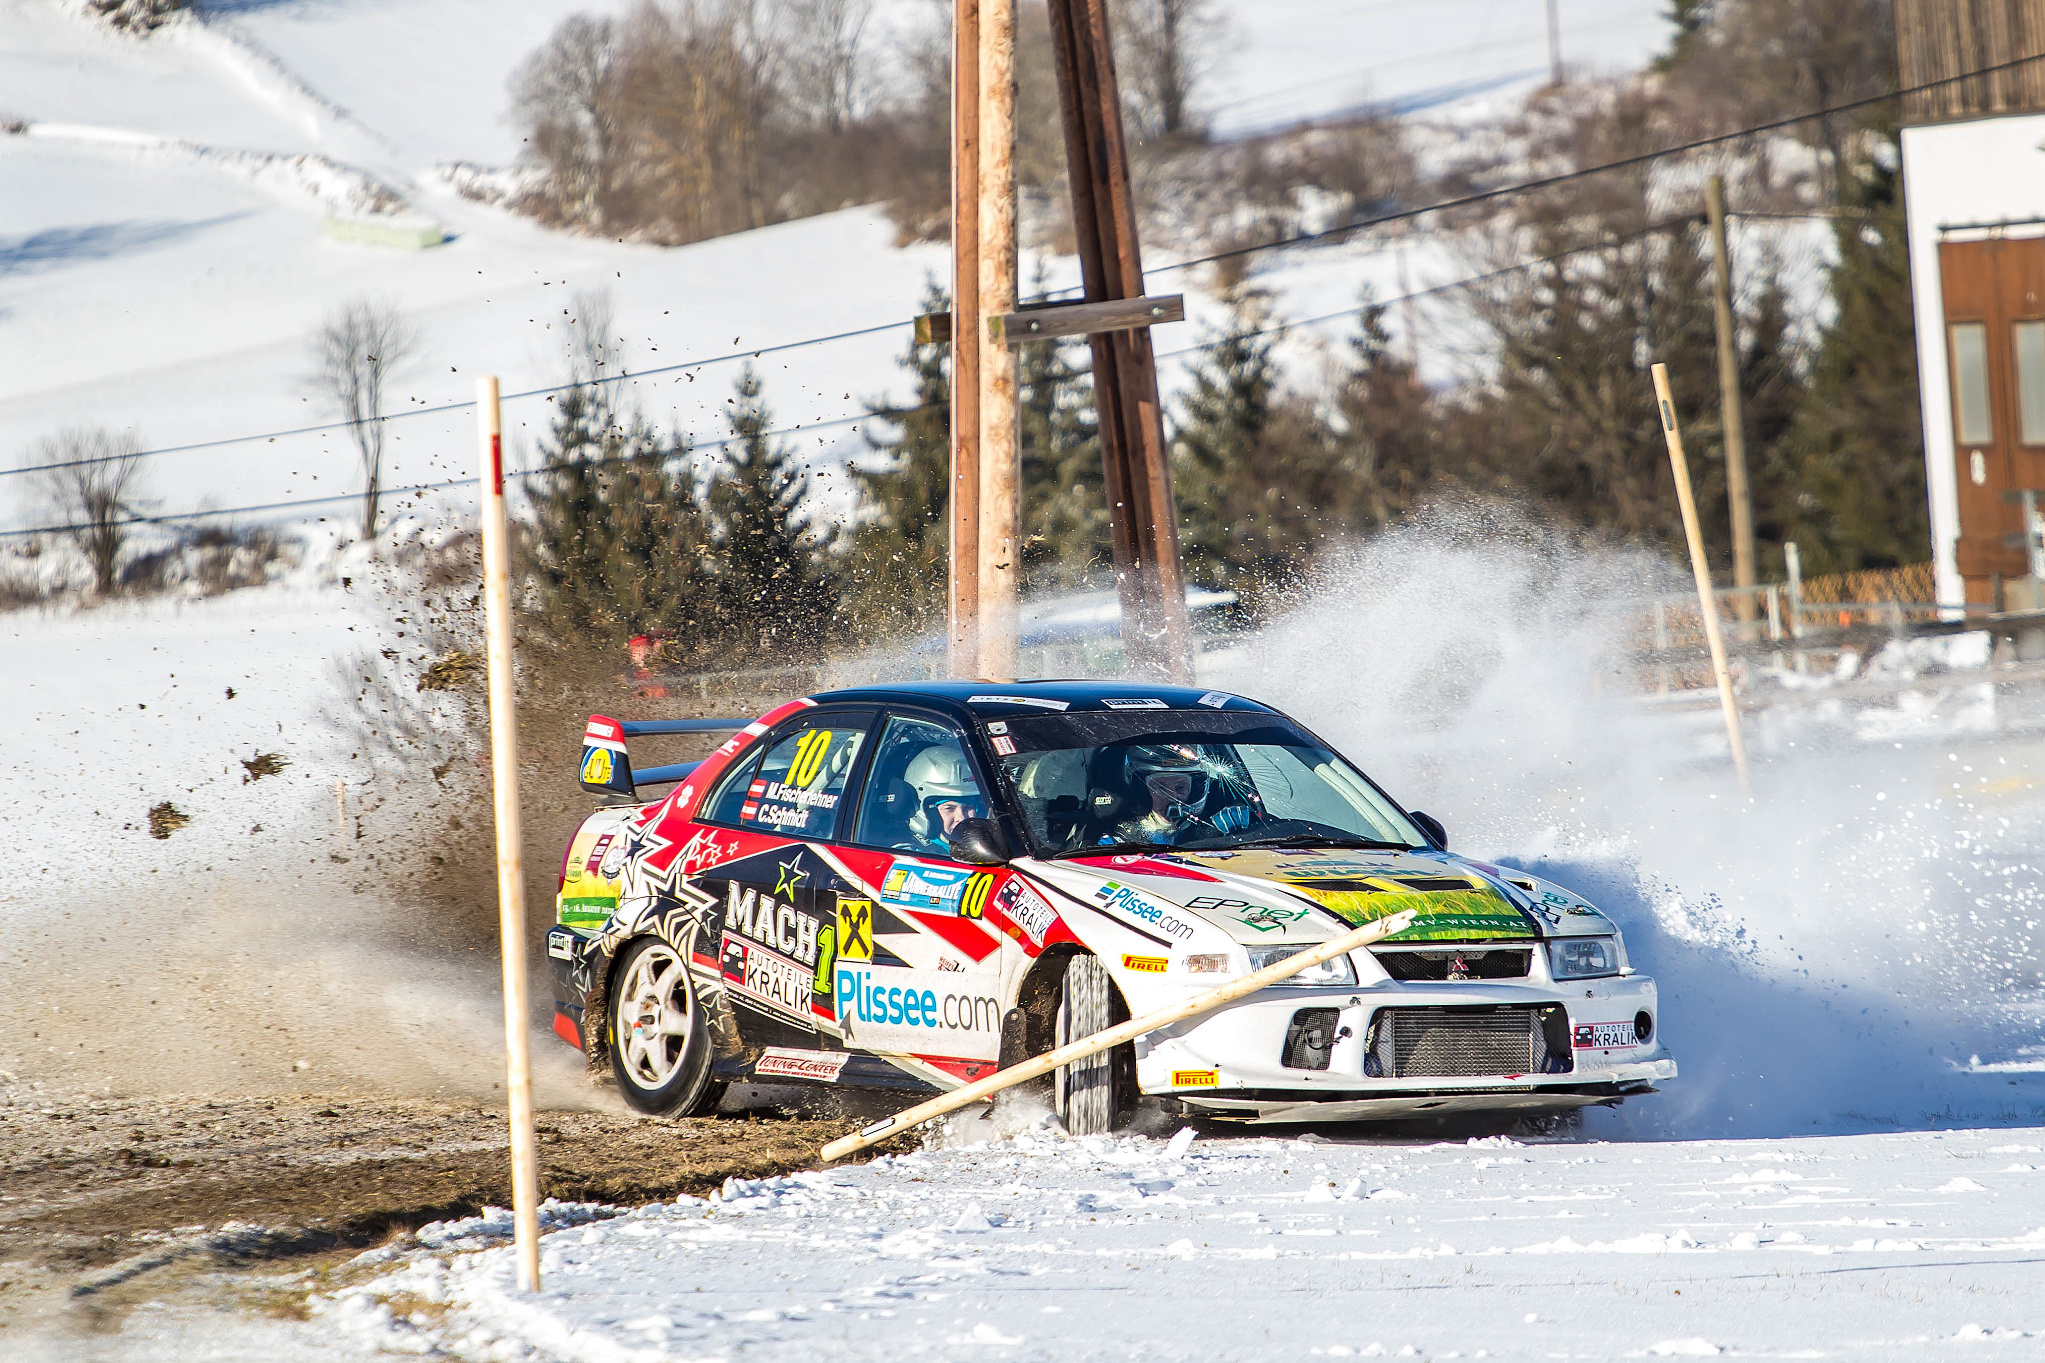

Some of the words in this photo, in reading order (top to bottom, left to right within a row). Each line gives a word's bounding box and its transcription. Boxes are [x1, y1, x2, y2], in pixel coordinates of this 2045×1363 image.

[785, 729, 832, 788] 10
[757, 803, 810, 828] C.Schmidt
[765, 781, 839, 809] M.Fischerlehner
[960, 871, 995, 918] 10
[1113, 886, 1194, 940] Plissee.com
[1184, 896, 1310, 922] EPnet
[725, 879, 820, 967] MACH
[814, 924, 835, 996] 1
[1011, 899, 1048, 943] KRALIK
[750, 951, 811, 990] AUTOTEILE
[1124, 956, 1169, 972] PIRELL
[747, 964, 811, 1015] KRALIK
[837, 969, 1001, 1034] Plissee.com
[1595, 1024, 1634, 1033] AUTOTEIL
[1175, 1071, 1215, 1085] PIRELLI
